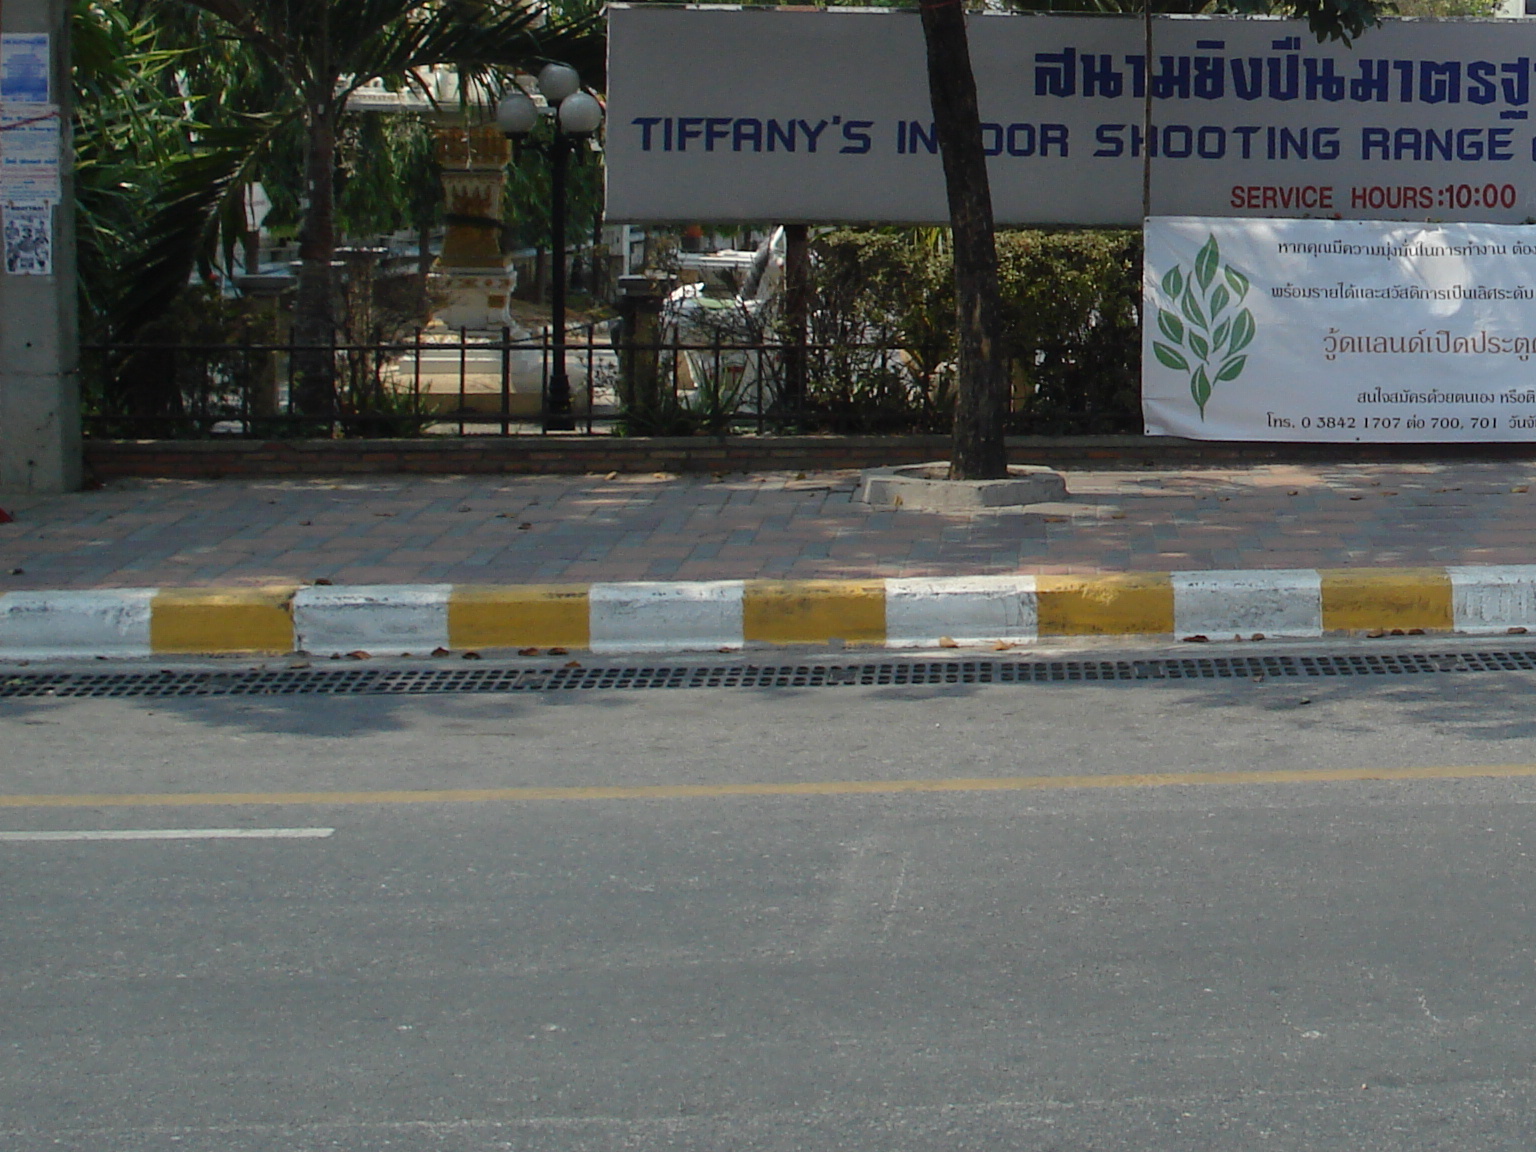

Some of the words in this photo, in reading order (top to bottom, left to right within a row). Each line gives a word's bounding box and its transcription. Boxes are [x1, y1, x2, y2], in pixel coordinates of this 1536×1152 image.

[631, 114, 875, 155] TIFFANY'S
[896, 120, 1069, 158] INOOR
[1092, 123, 1340, 161] SHOOTING
[1361, 127, 1516, 162] RANGE
[1230, 185, 1333, 209] SERVICE
[1266, 411, 1296, 430] โทร.
[1301, 416, 1312, 430] 0
[1316, 416, 1356, 430] 3842
[1363, 417, 1401, 430] 1707
[1406, 413, 1426, 431] ต่อ
[1431, 417, 1465, 432] 700,
[1470, 416, 1498, 430] 701
